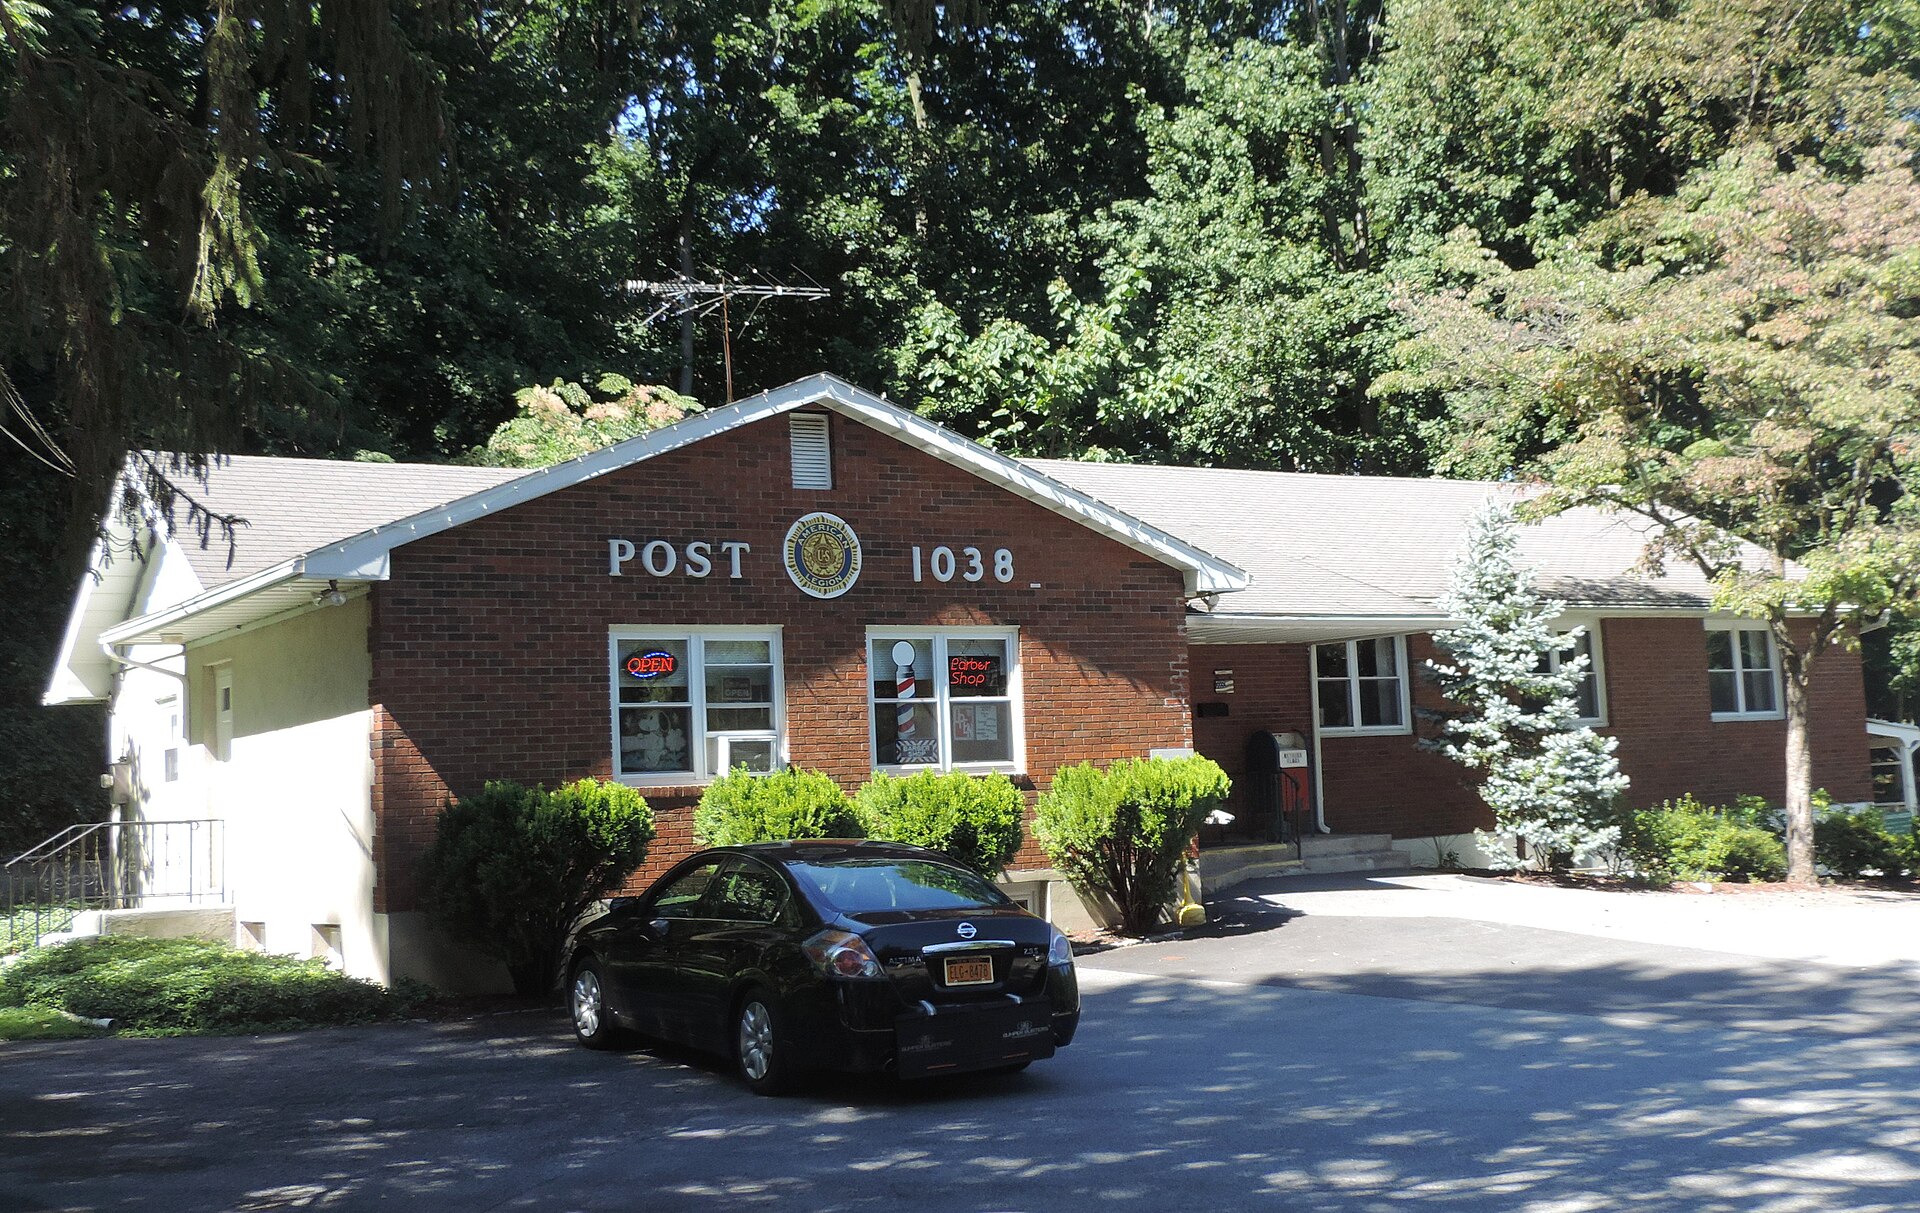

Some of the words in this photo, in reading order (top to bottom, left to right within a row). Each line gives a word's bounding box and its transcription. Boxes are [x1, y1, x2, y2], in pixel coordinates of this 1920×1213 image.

[798, 524, 850, 549] AMERICAN
[608, 539, 751, 580] POST
[912, 546, 1015, 583] 1038
[805, 573, 843, 587] LEGION
[627, 657, 674, 672] OPEN
[951, 657, 990, 671] Barber
[950, 671, 985, 687] Shop
